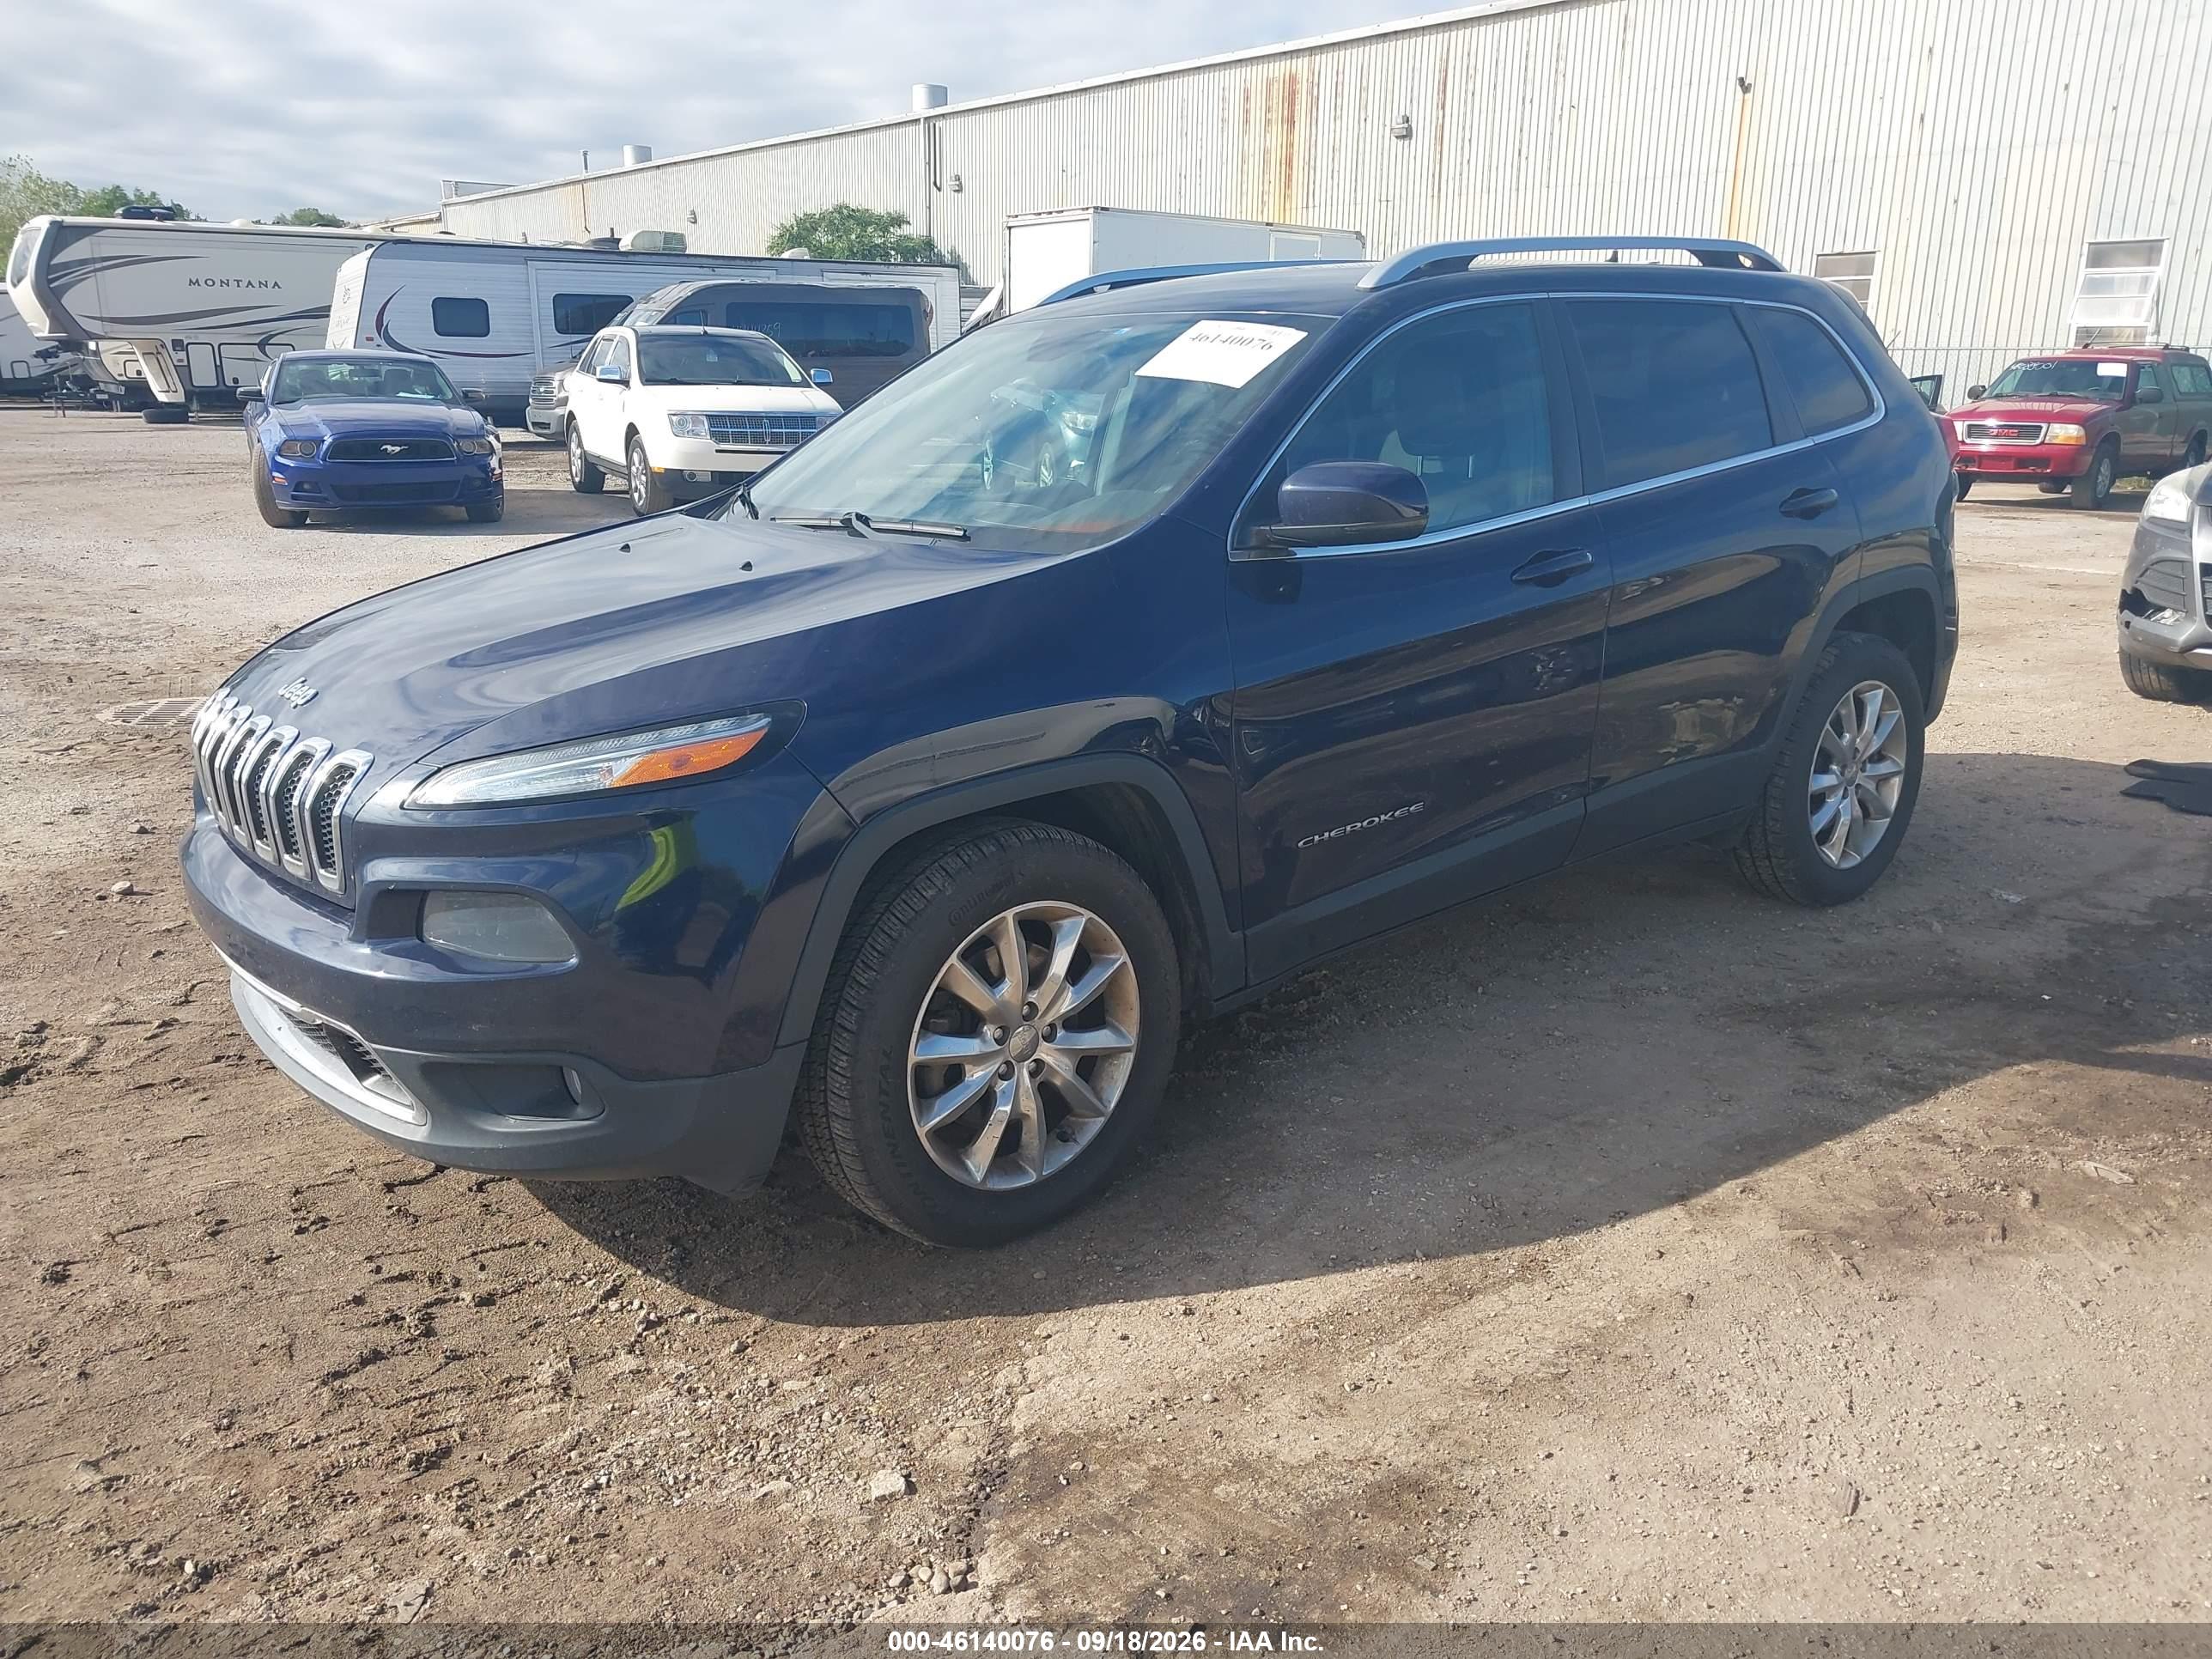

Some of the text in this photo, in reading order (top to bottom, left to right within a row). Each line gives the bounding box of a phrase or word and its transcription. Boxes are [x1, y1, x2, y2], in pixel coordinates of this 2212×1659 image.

[188, 277, 282, 289] MONTANA
[1188, 332, 1273, 350] 46140076
[1987, 428, 2020, 437] GMC
[277, 677, 319, 708] Jeep
[1297, 801, 1425, 848] CHEROKEE
[878, 1042, 943, 1215] ONTINENTAL
